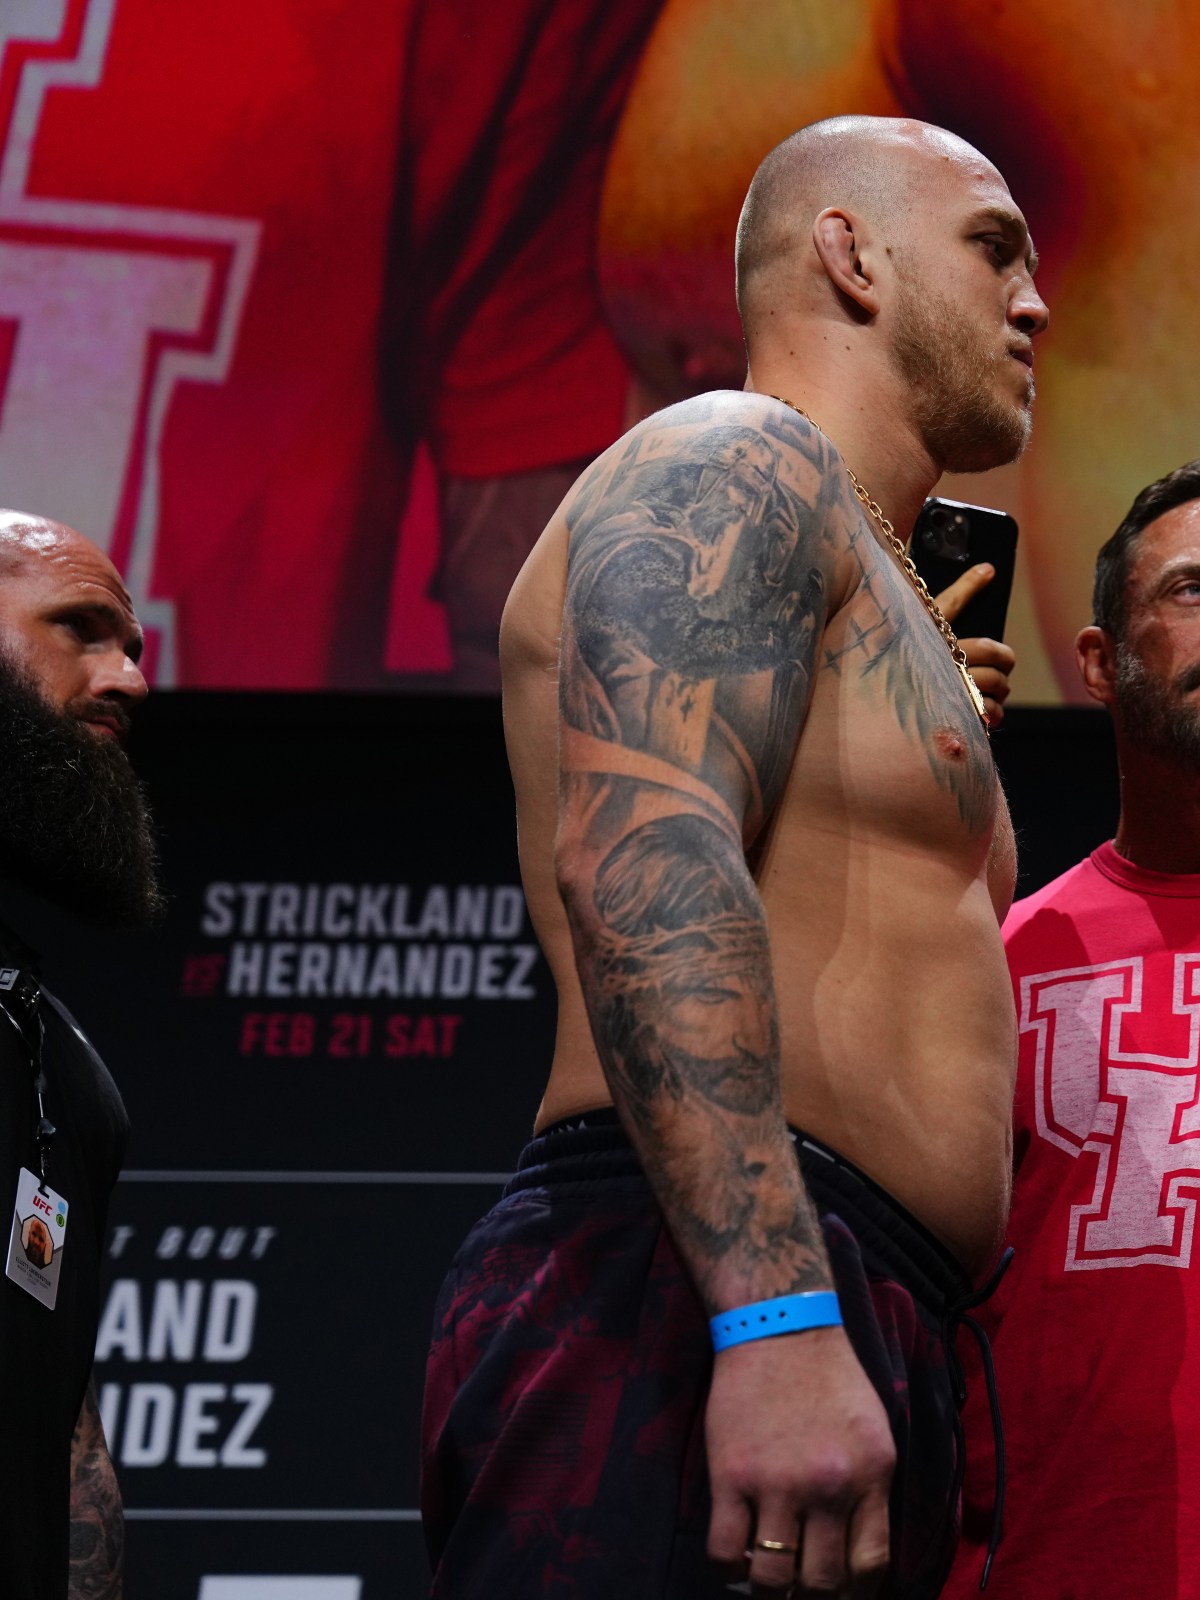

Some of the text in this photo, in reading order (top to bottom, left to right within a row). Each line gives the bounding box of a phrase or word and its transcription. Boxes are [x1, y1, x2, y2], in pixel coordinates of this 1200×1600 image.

[202, 881, 525, 939] STRICKLAND
[227, 941, 538, 999] HERNANDEZ
[239, 1011, 463, 1058] FEB 21 SAT
[33, 1196, 52, 1216] UFC
[155, 1225, 279, 1261] BOUT
